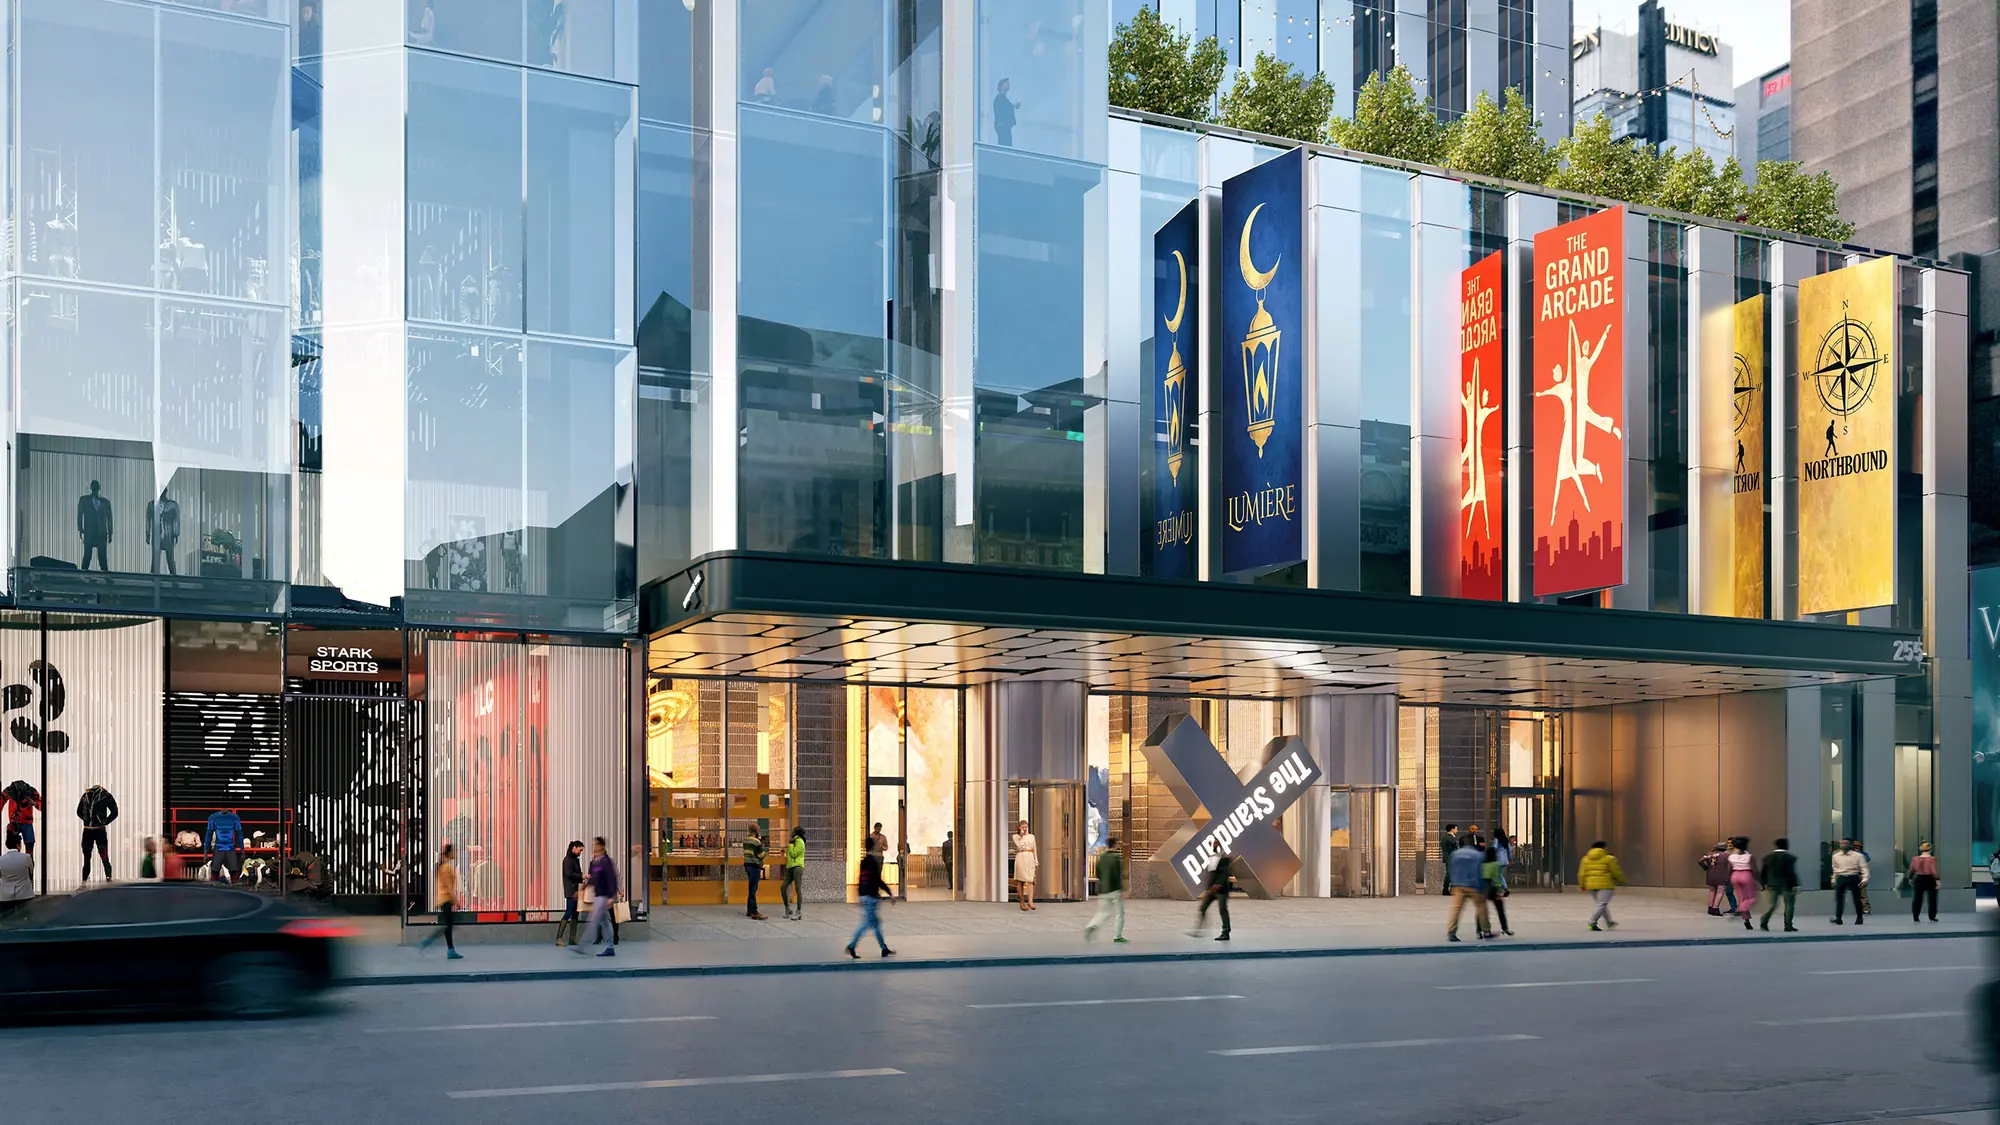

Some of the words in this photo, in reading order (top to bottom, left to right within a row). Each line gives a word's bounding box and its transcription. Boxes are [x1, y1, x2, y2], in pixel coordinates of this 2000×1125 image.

[1566, 232, 1588, 254] THE
[1546, 247, 1609, 290] GRAND
[1541, 276, 1614, 321] ARCADE
[1842, 300, 1849, 310] N
[1883, 354, 1889, 364] E
[1802, 371, 1811, 381] W
[1804, 450, 1888, 482] NORTHBOUND
[1228, 482, 1295, 532] LUMIÈRE
[317, 646, 372, 659] STARK
[1893, 640, 1923, 662] 255
[310, 660, 379, 673] SPORTS
[1269, 751, 1312, 794] The
[1182, 786, 1275, 885] Standard
